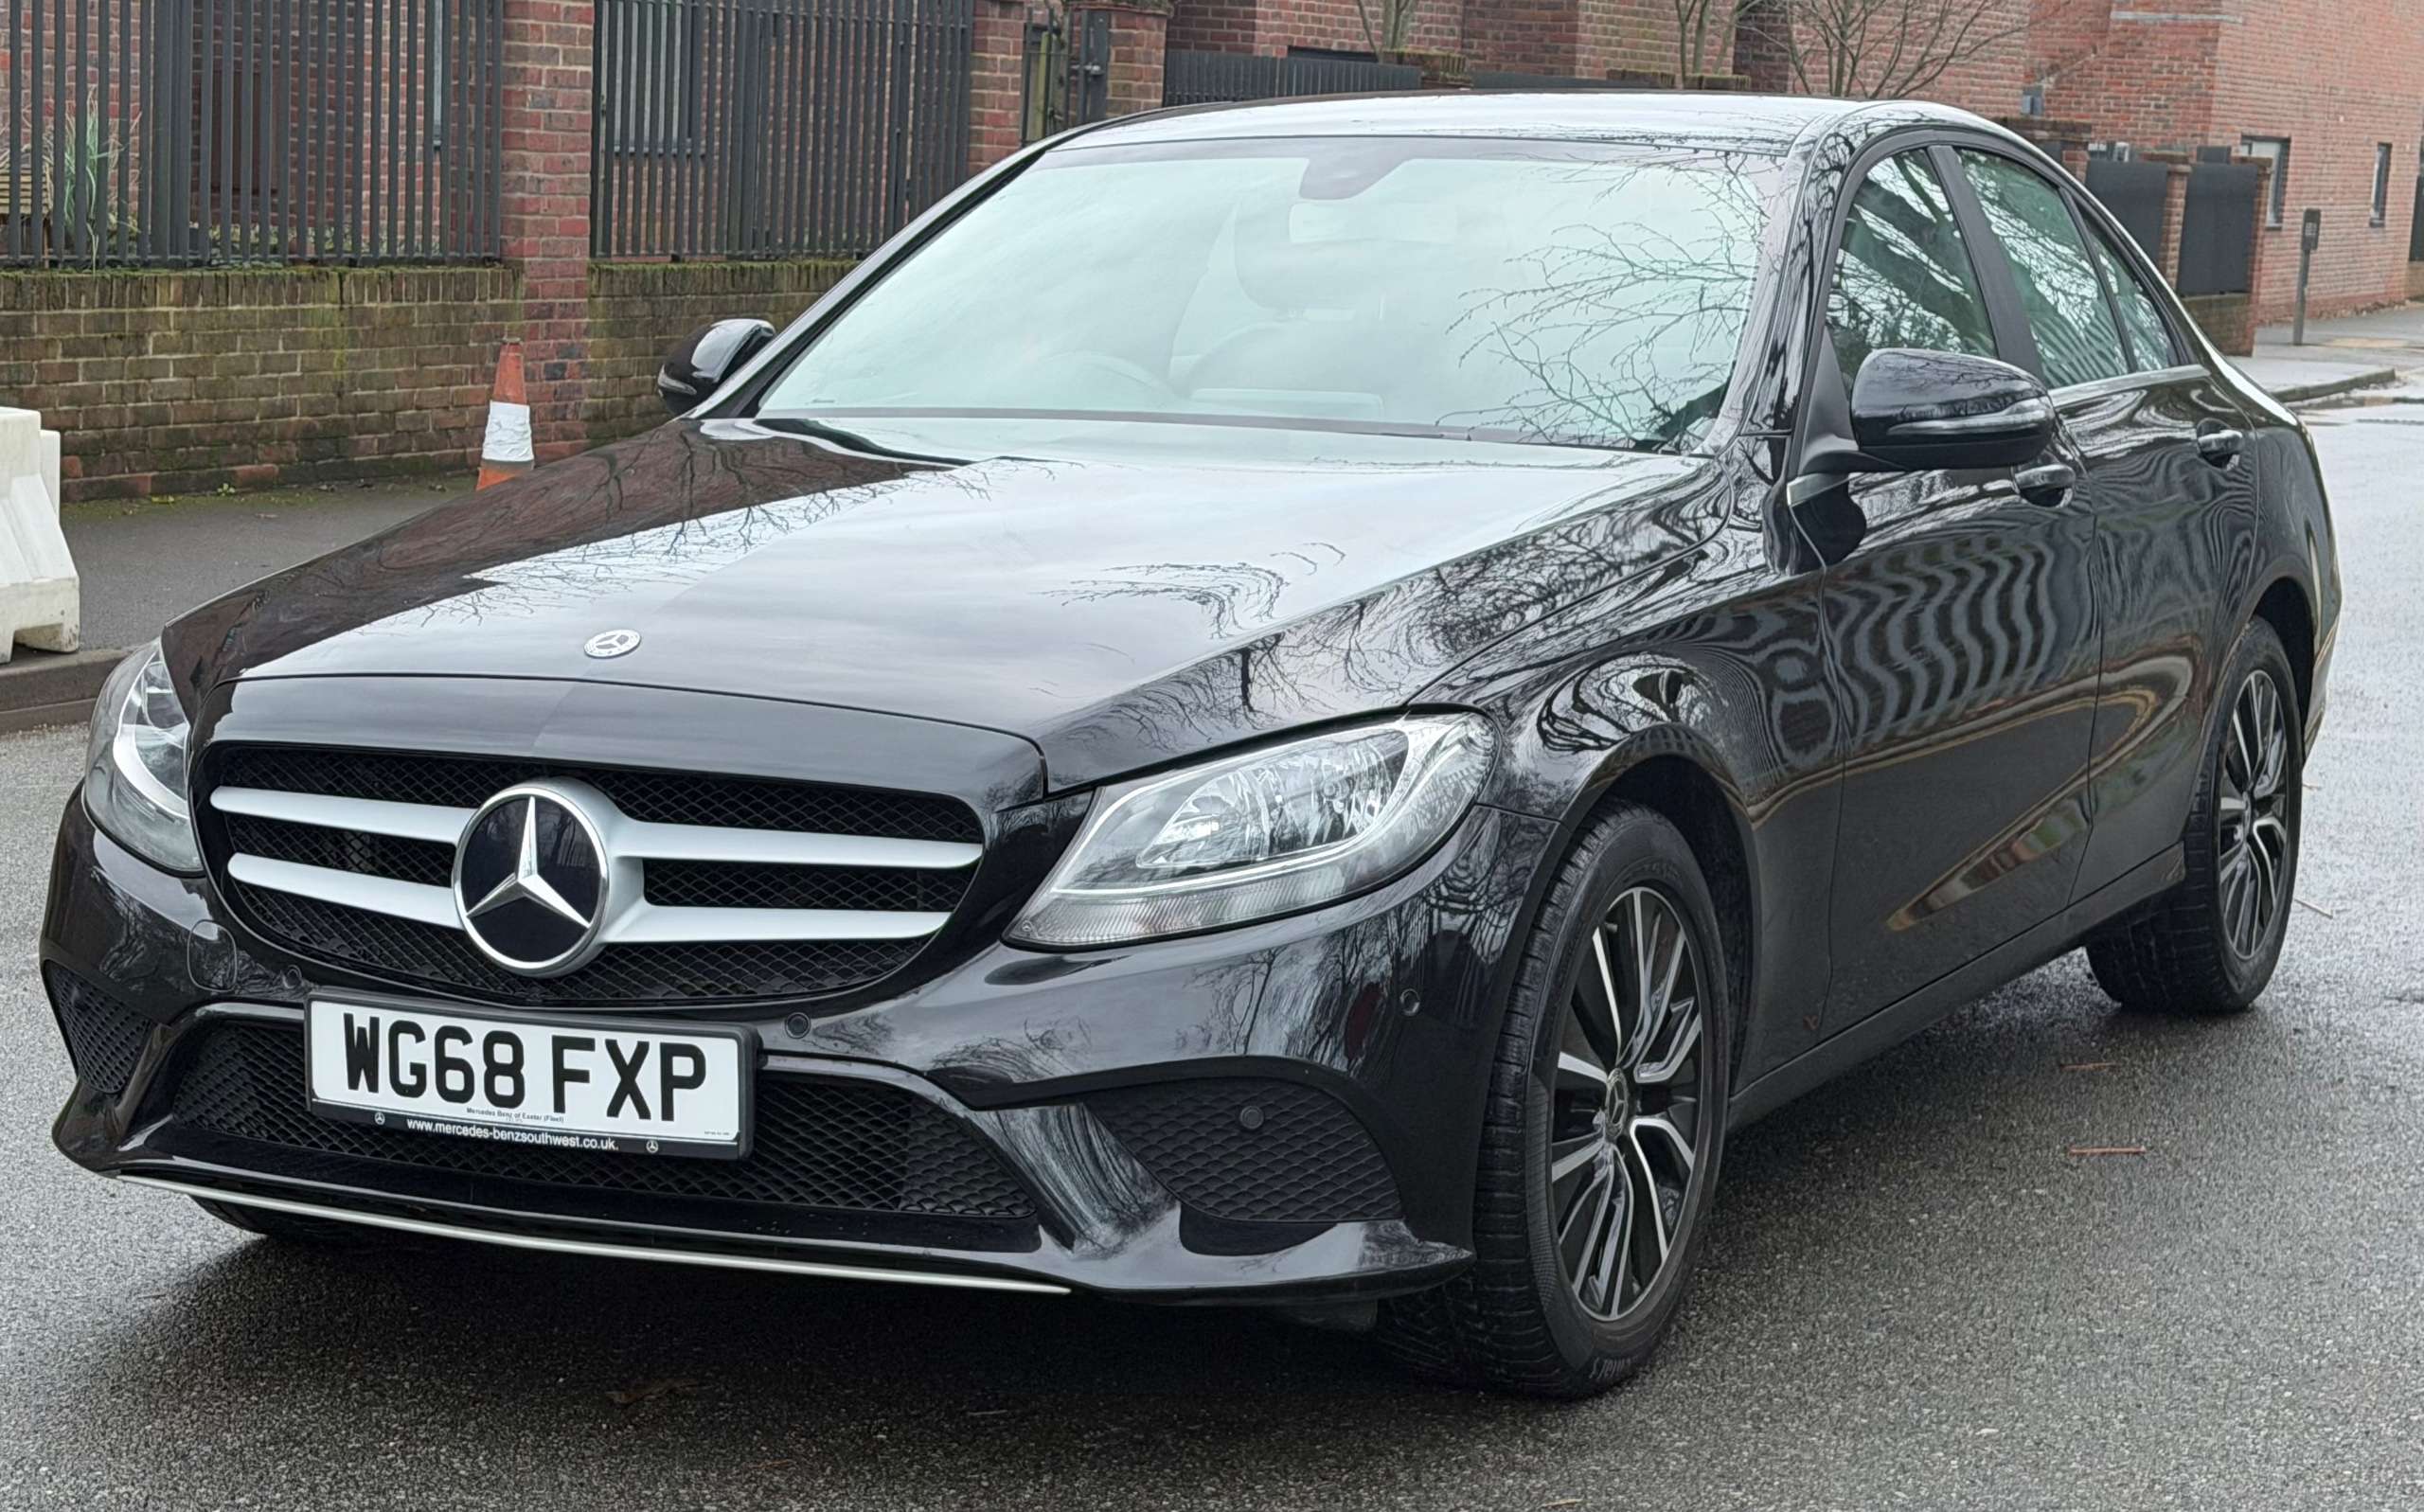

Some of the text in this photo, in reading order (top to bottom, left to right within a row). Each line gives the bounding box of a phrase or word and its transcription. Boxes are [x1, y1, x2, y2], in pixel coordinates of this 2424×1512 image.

[343, 1012, 706, 1122] WG68 FXP
[466, 1107, 496, 1117] Mercedes
